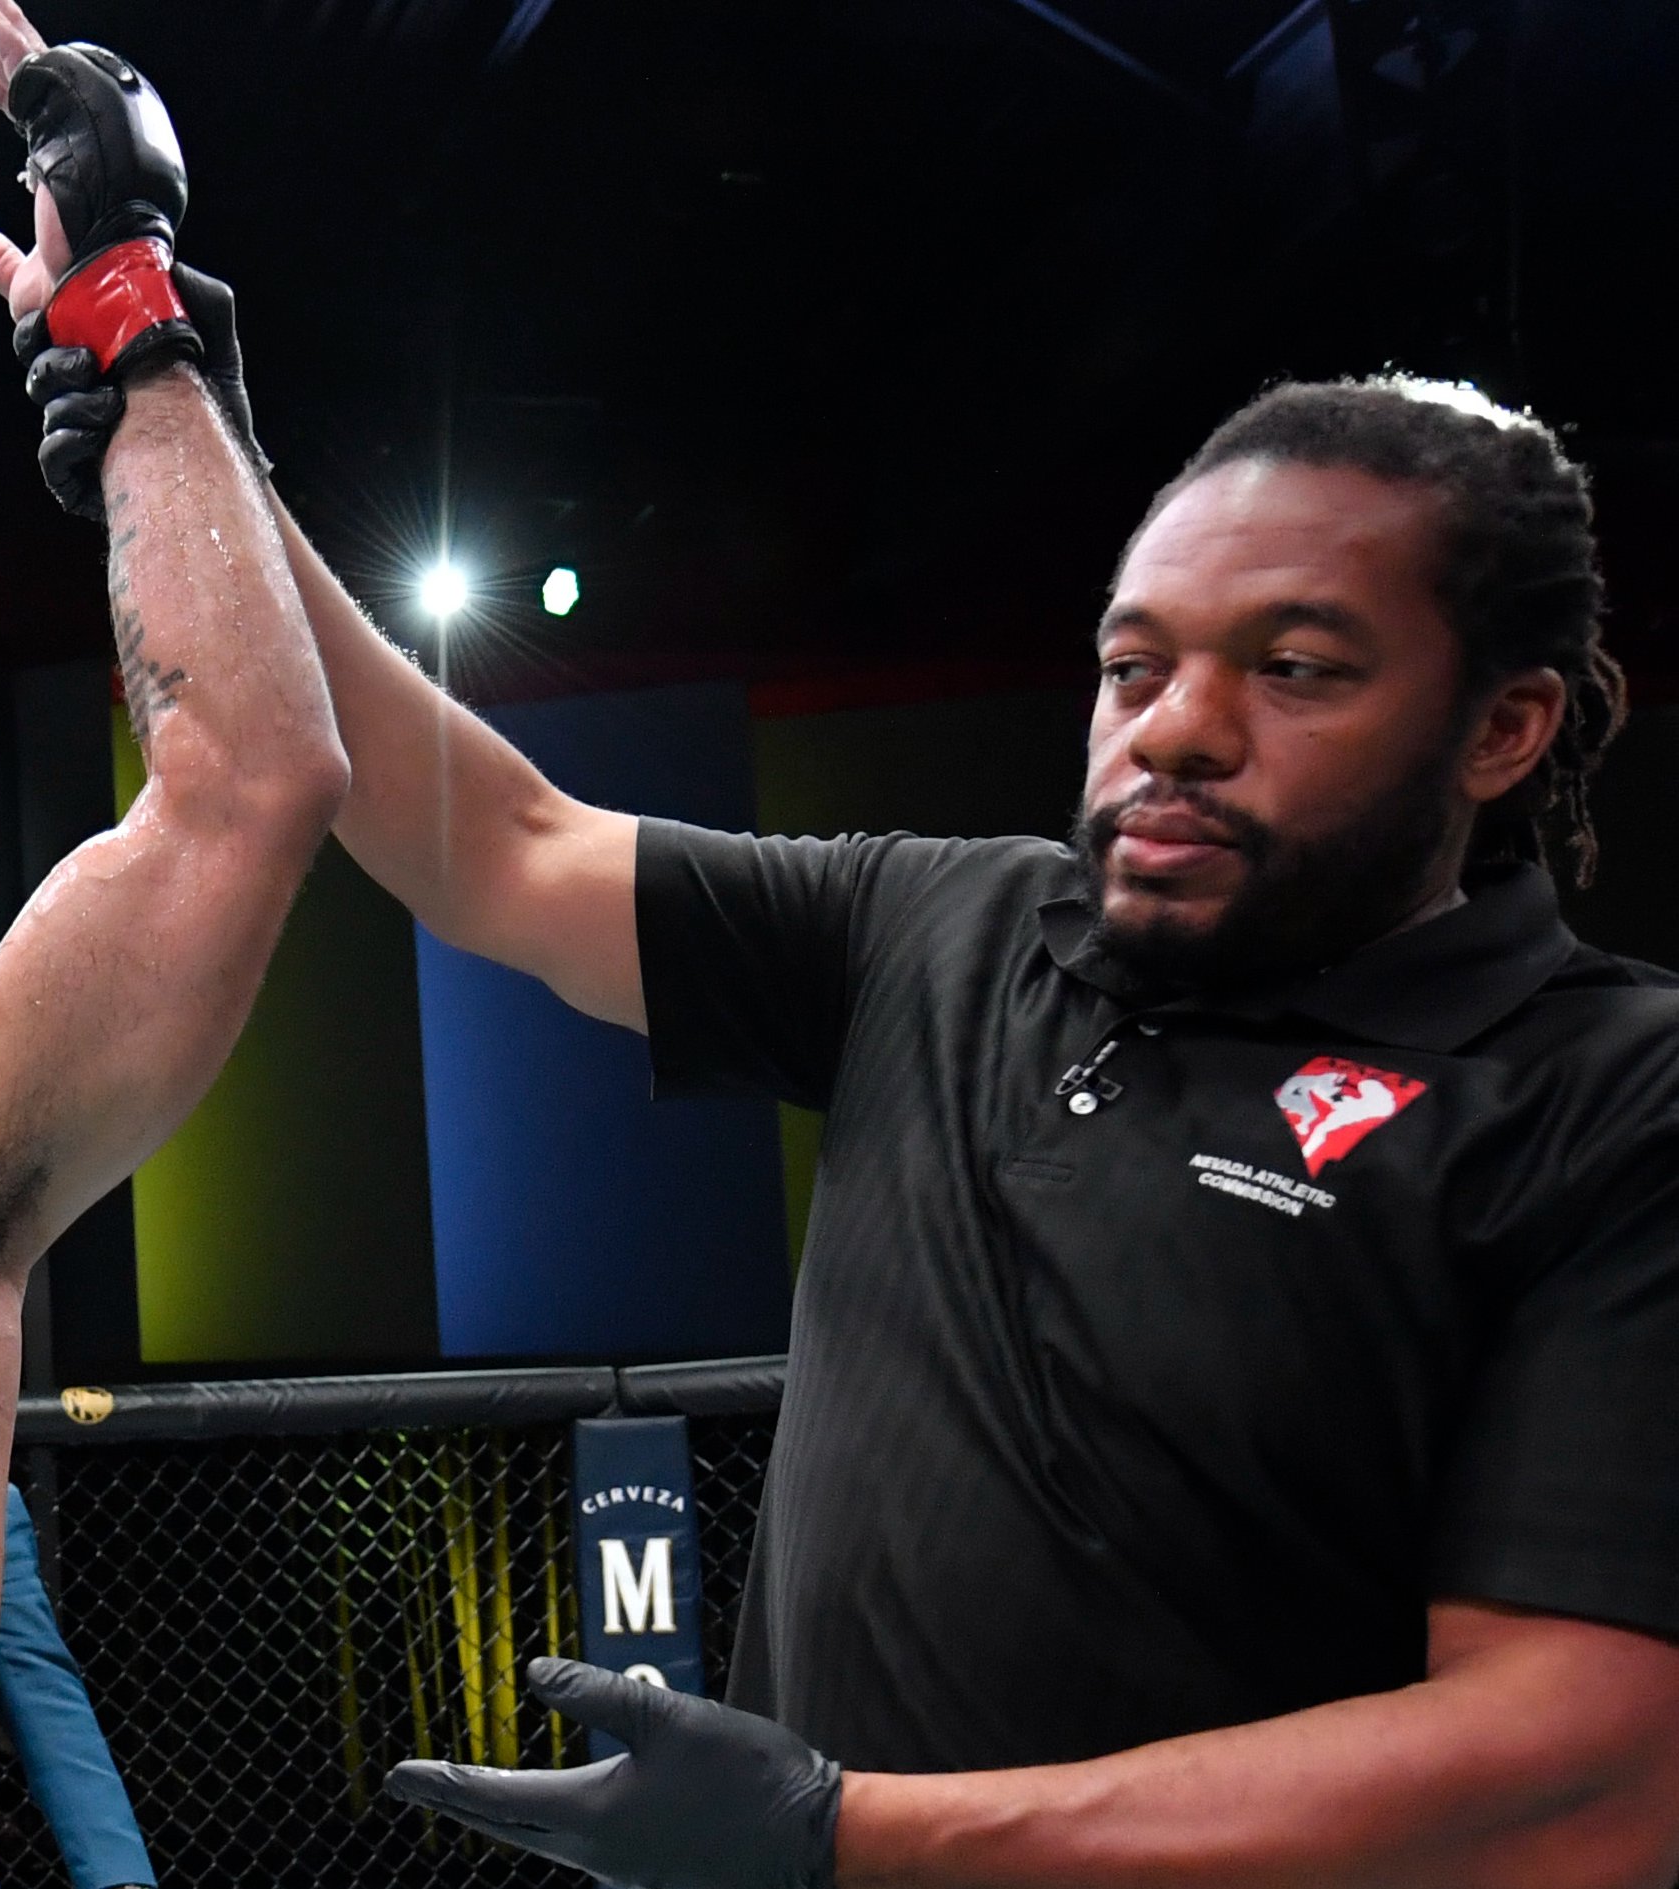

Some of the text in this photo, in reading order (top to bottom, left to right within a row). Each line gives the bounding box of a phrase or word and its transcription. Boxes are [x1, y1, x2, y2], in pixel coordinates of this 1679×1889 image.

[1188, 1153, 1337, 1208] NEVADA ATHLETIC
[1198, 1172, 1306, 1217] COMMISSION
[581, 1485, 685, 1515] CERVEZA
